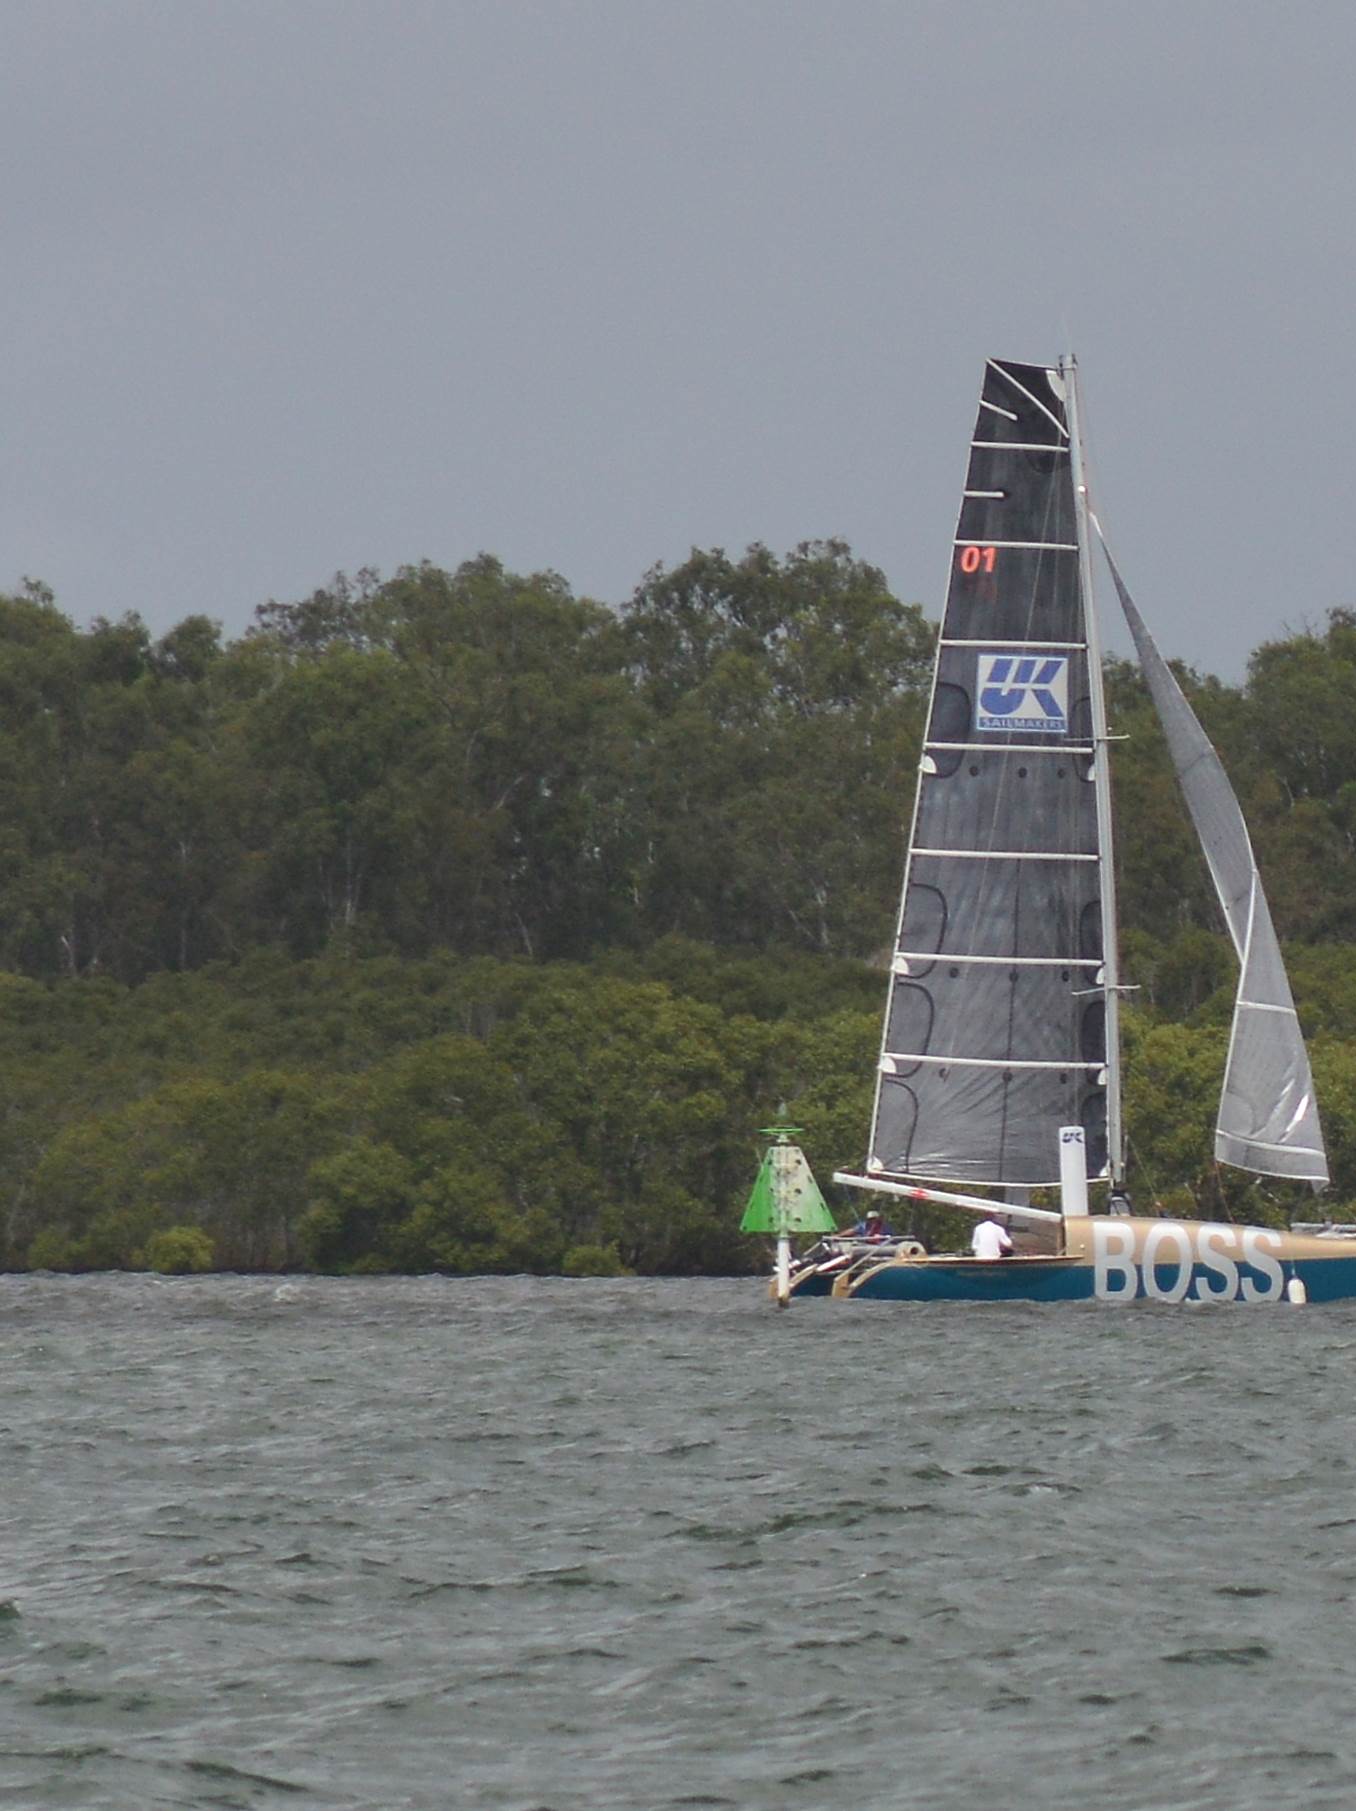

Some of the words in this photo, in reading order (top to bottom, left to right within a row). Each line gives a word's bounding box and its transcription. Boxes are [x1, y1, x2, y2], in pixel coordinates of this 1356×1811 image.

[961, 546, 996, 573] 01
[980, 658, 1064, 717] UK
[982, 718, 1062, 729] SAILMAKERS
[1093, 1221, 1284, 1303] BOSS
